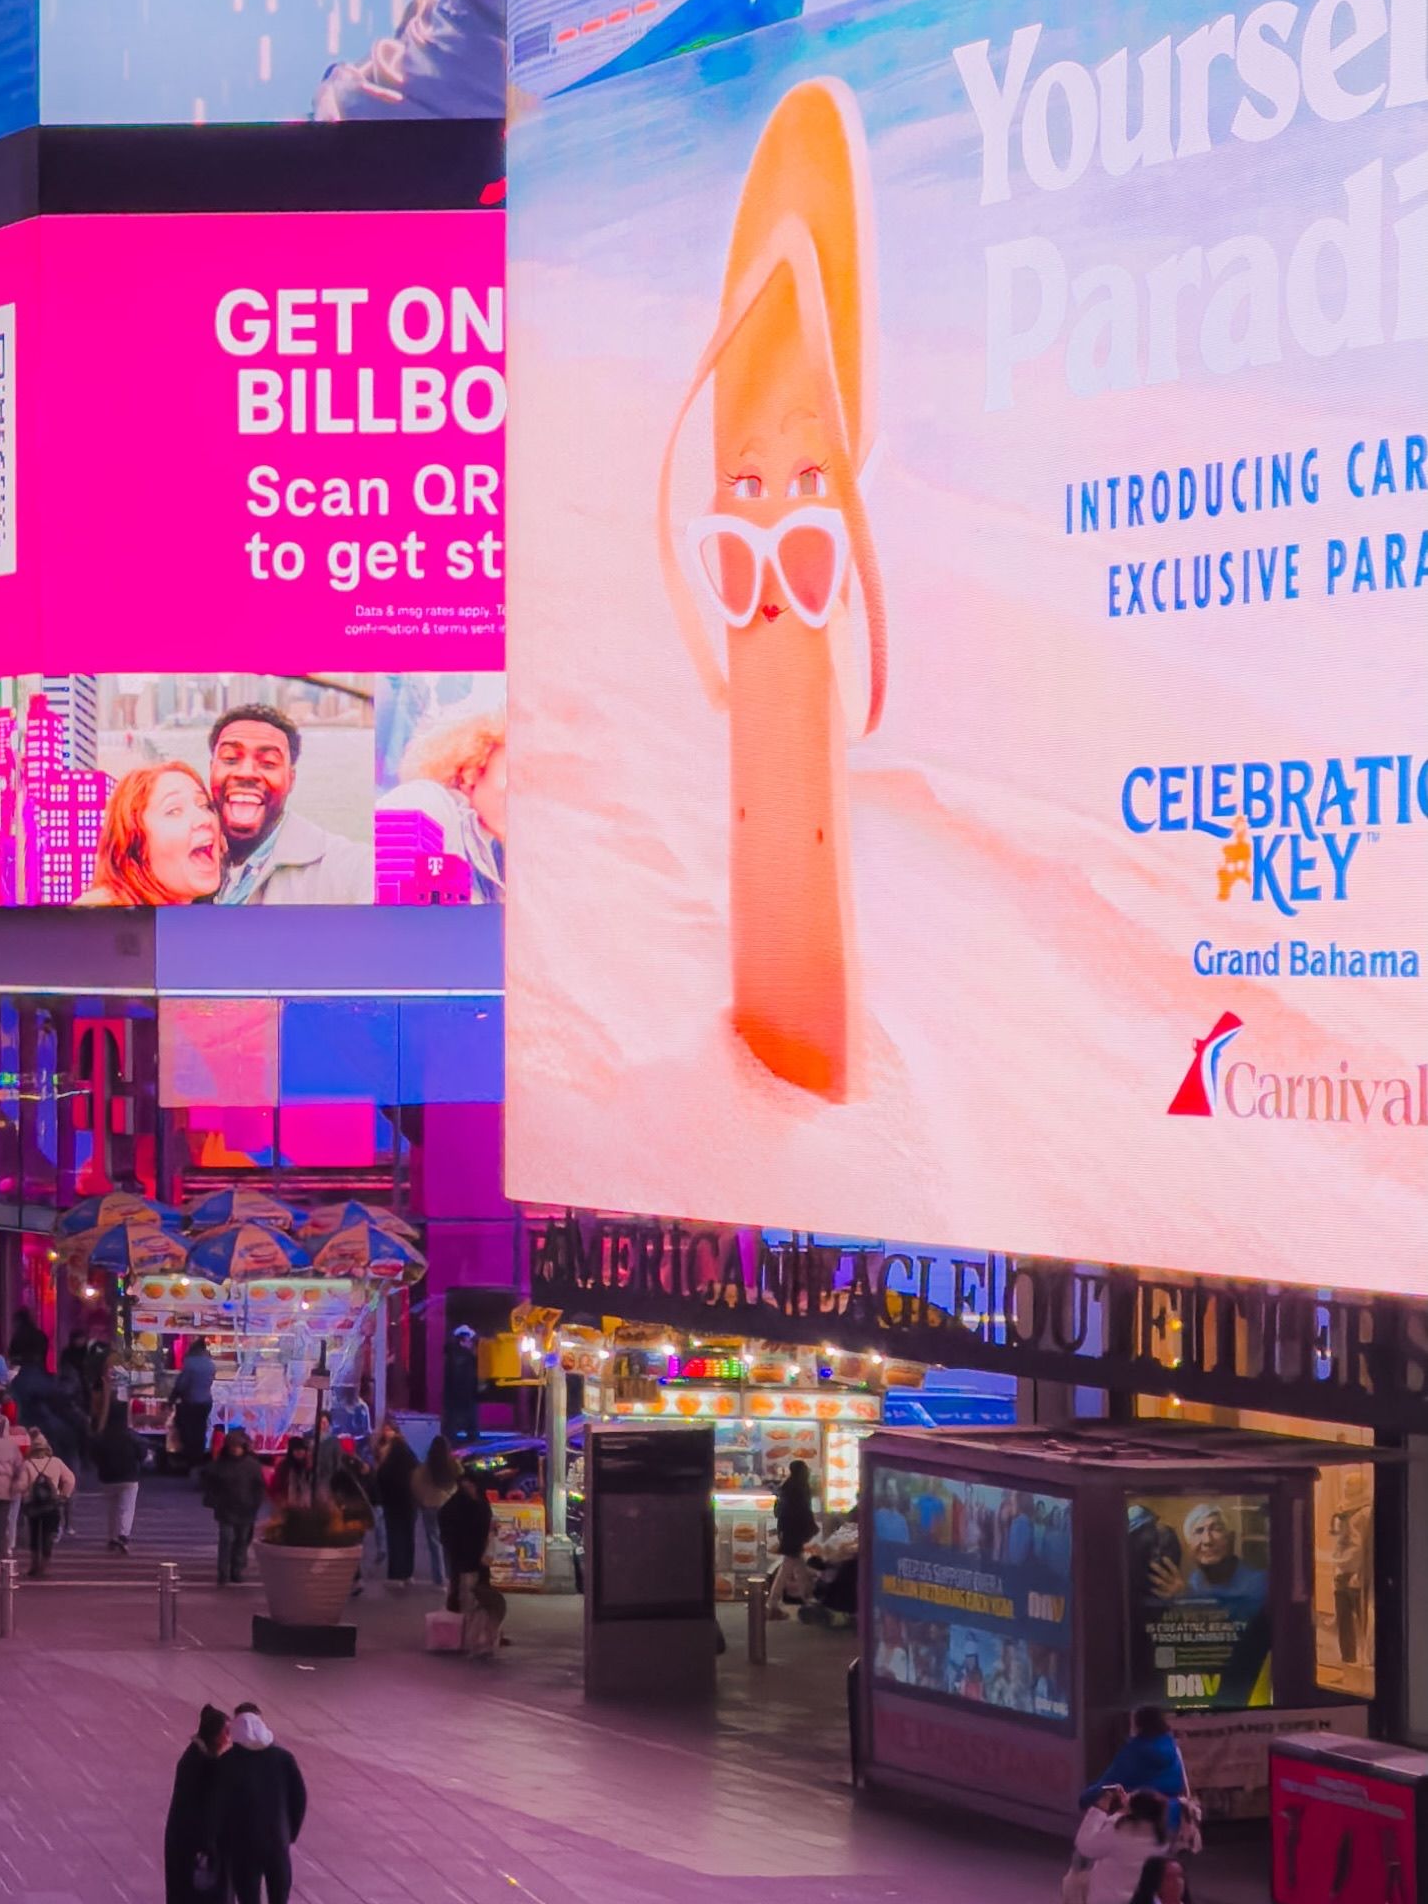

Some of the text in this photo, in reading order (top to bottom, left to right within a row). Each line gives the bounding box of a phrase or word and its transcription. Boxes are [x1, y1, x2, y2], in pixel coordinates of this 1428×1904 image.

[214, 286, 504, 356] GET ON
[237, 364, 507, 435] BILLBO
[246, 463, 499, 518] Scan QR
[1065, 446, 1320, 535] INTRODUCING
[245, 530, 503, 592] to get st
[1107, 543, 1301, 618] EXCLUSIVE
[355, 605, 383, 618] Data
[1252, 831, 1362, 917] KEY
[1193, 940, 1420, 978] Grand Bahama
[1224, 1059, 1428, 1128] Carnival
